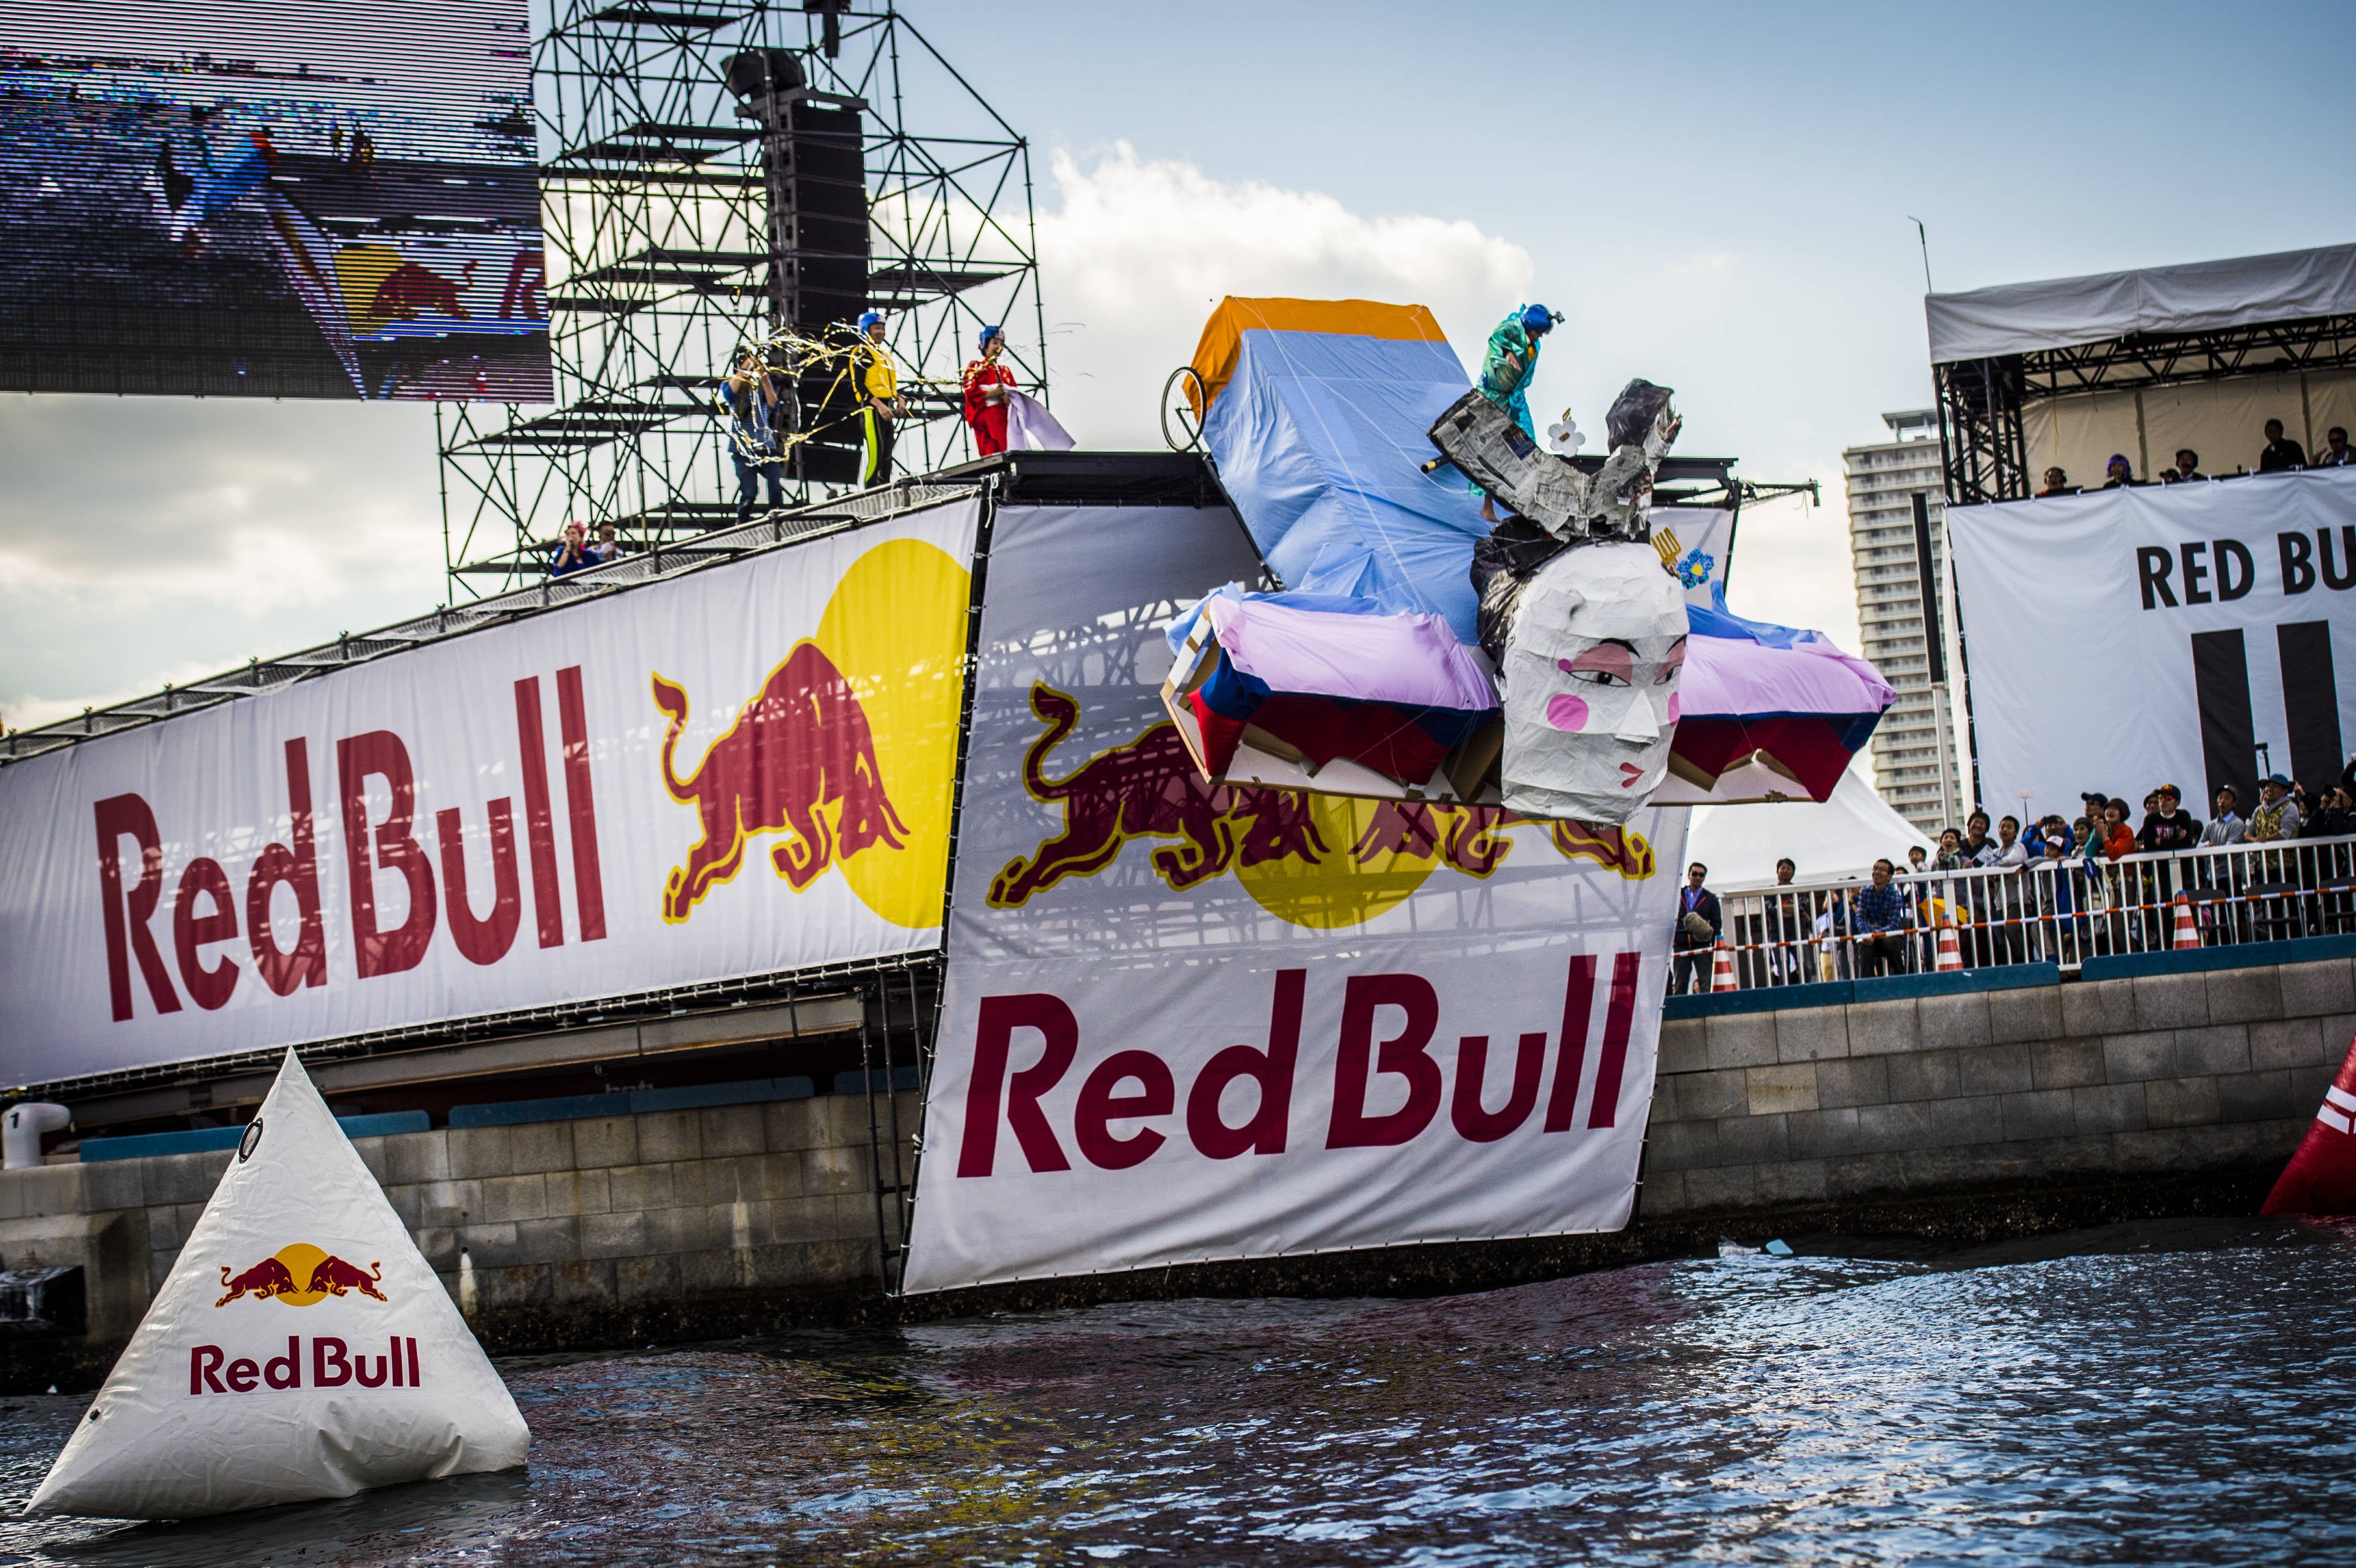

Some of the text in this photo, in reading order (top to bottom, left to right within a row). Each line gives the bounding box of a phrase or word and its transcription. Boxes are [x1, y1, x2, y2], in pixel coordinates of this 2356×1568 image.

[2136, 539, 2255, 610] RED
[96, 665, 607, 1022] Red Bull
[957, 951, 1641, 1178] Red Bull
[10, 1112, 20, 1129] 1
[190, 1335, 421, 1395] Red Bull
